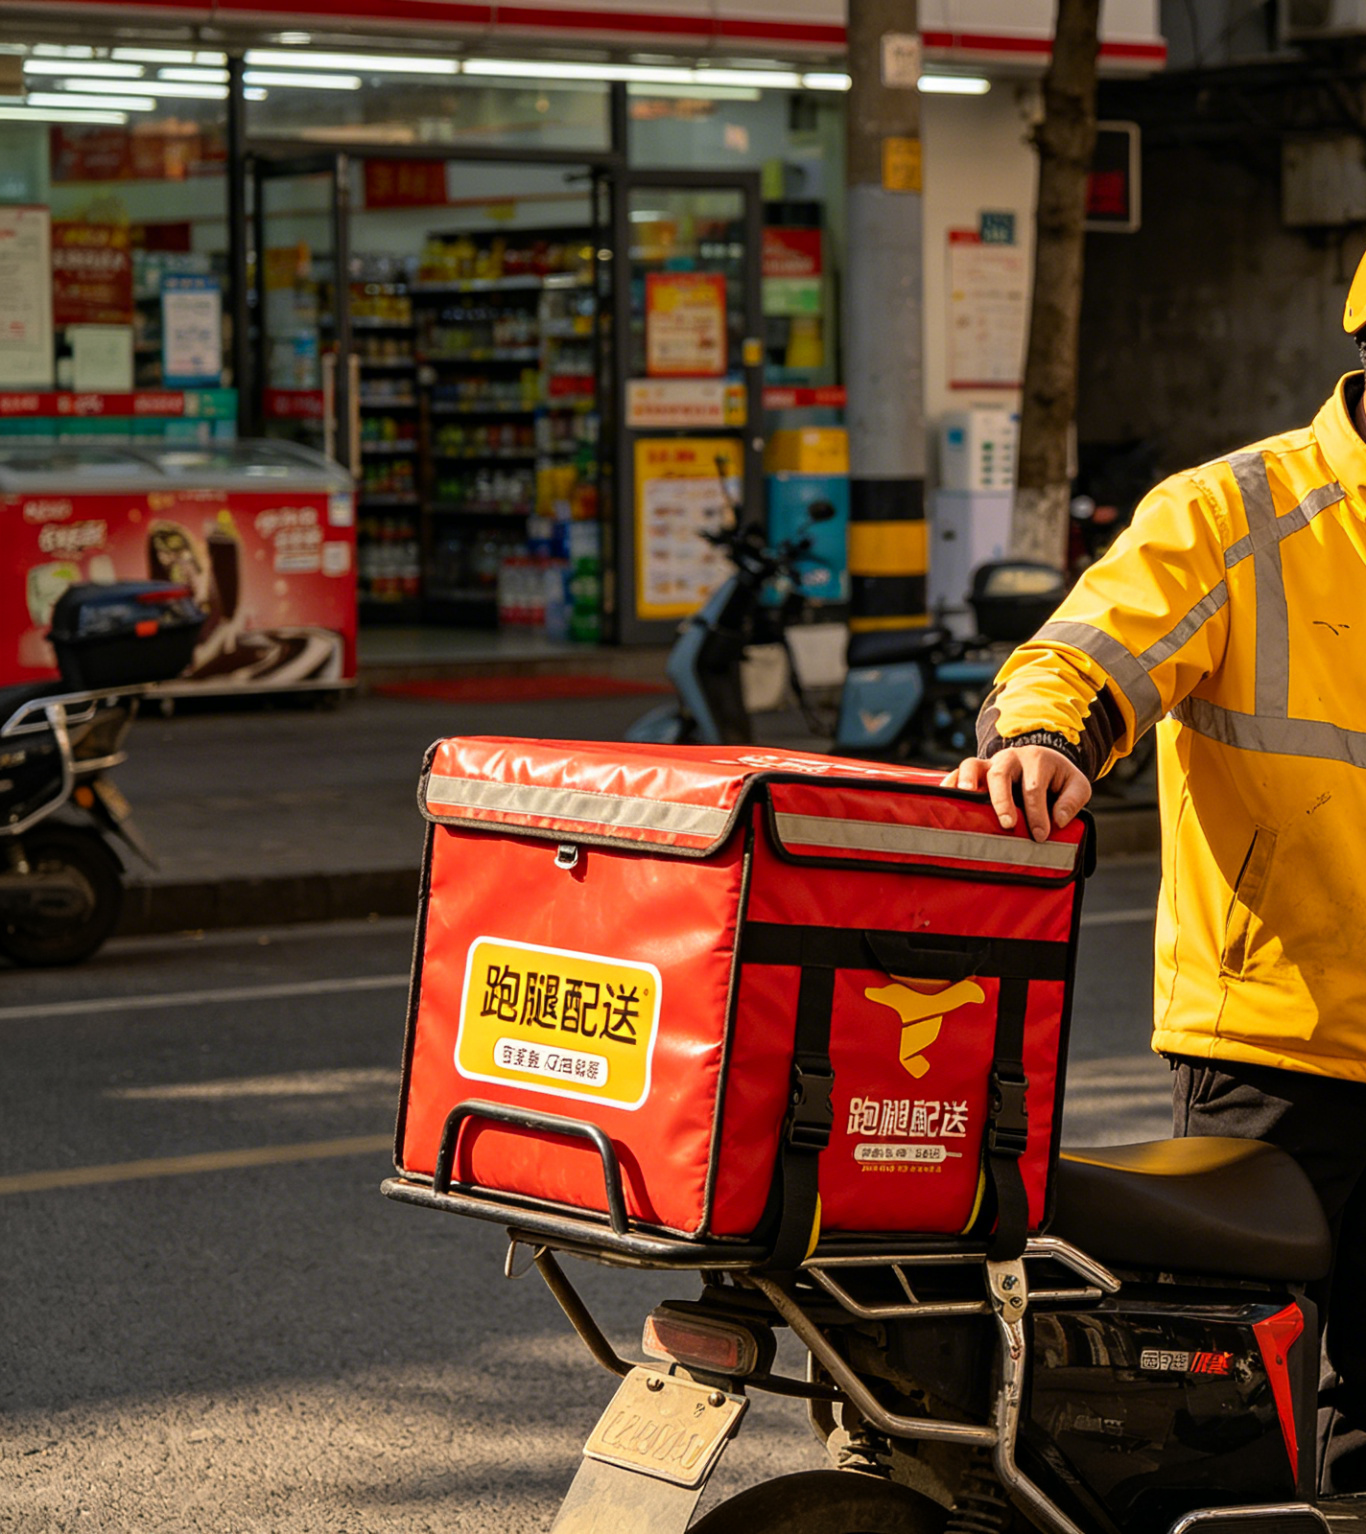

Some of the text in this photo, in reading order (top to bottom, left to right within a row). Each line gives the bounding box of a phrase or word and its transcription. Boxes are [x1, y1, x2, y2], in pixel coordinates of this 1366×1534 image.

[480, 964, 640, 1045] 跑腿配送
[846, 1095, 969, 1138] 跑腿配送
